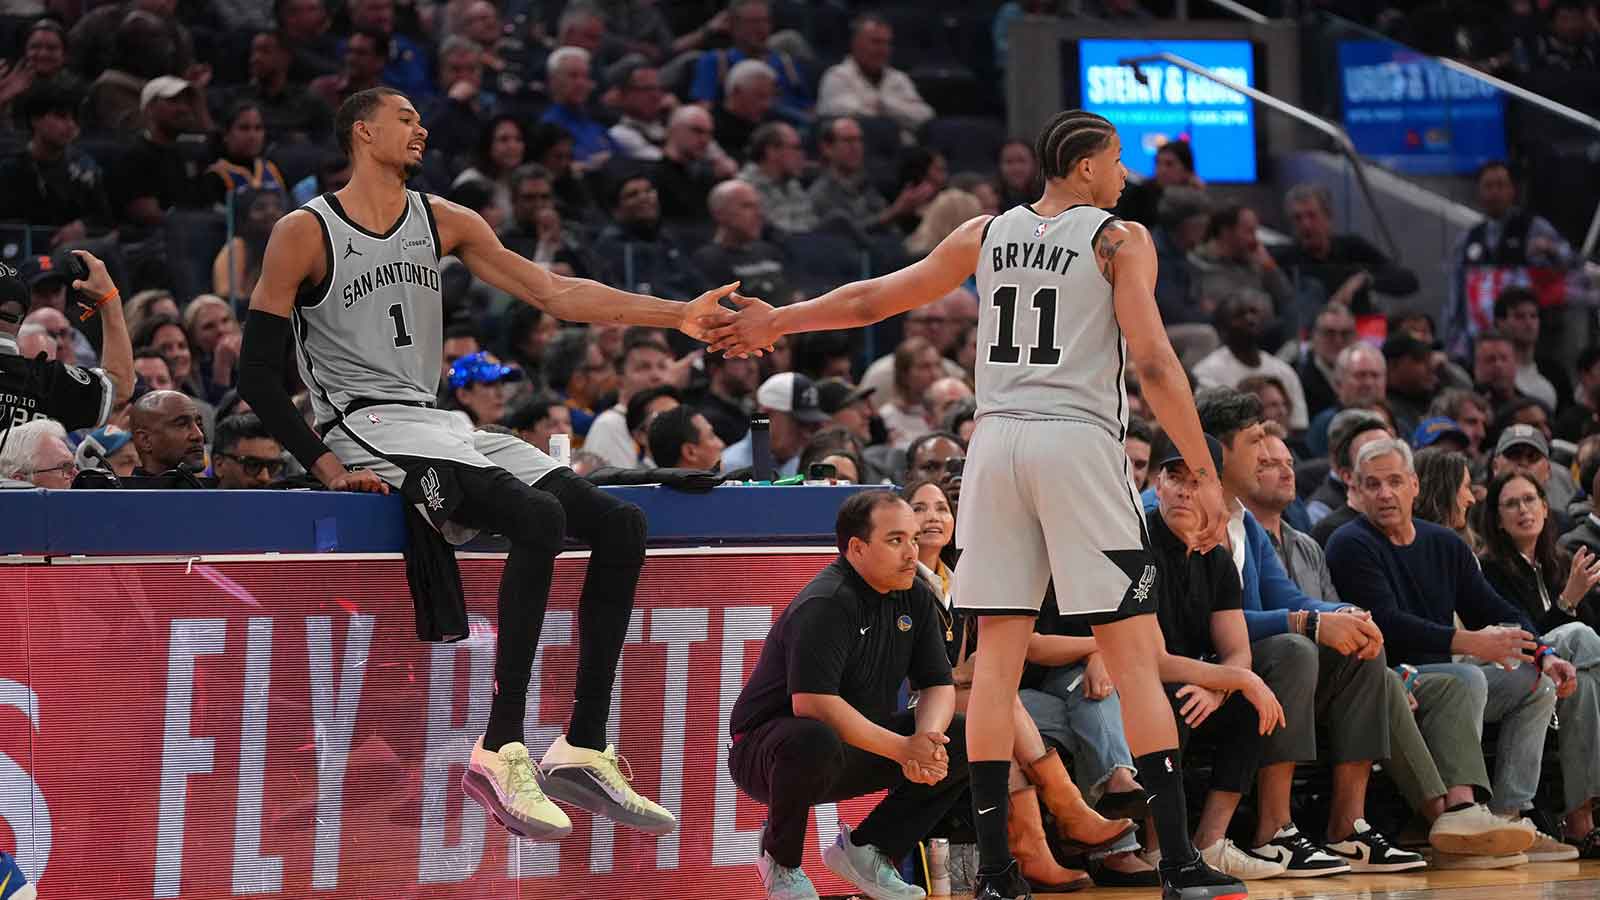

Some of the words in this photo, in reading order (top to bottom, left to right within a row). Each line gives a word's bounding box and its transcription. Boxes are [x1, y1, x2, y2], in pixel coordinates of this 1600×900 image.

[992, 242, 1079, 276] BRYANT
[343, 271, 374, 309] SAN
[375, 261, 440, 294] ANTONIO
[388, 302, 414, 348] 1
[983, 284, 1063, 366] 11
[153, 615, 376, 898] FLY
[417, 606, 842, 885] BETTE
